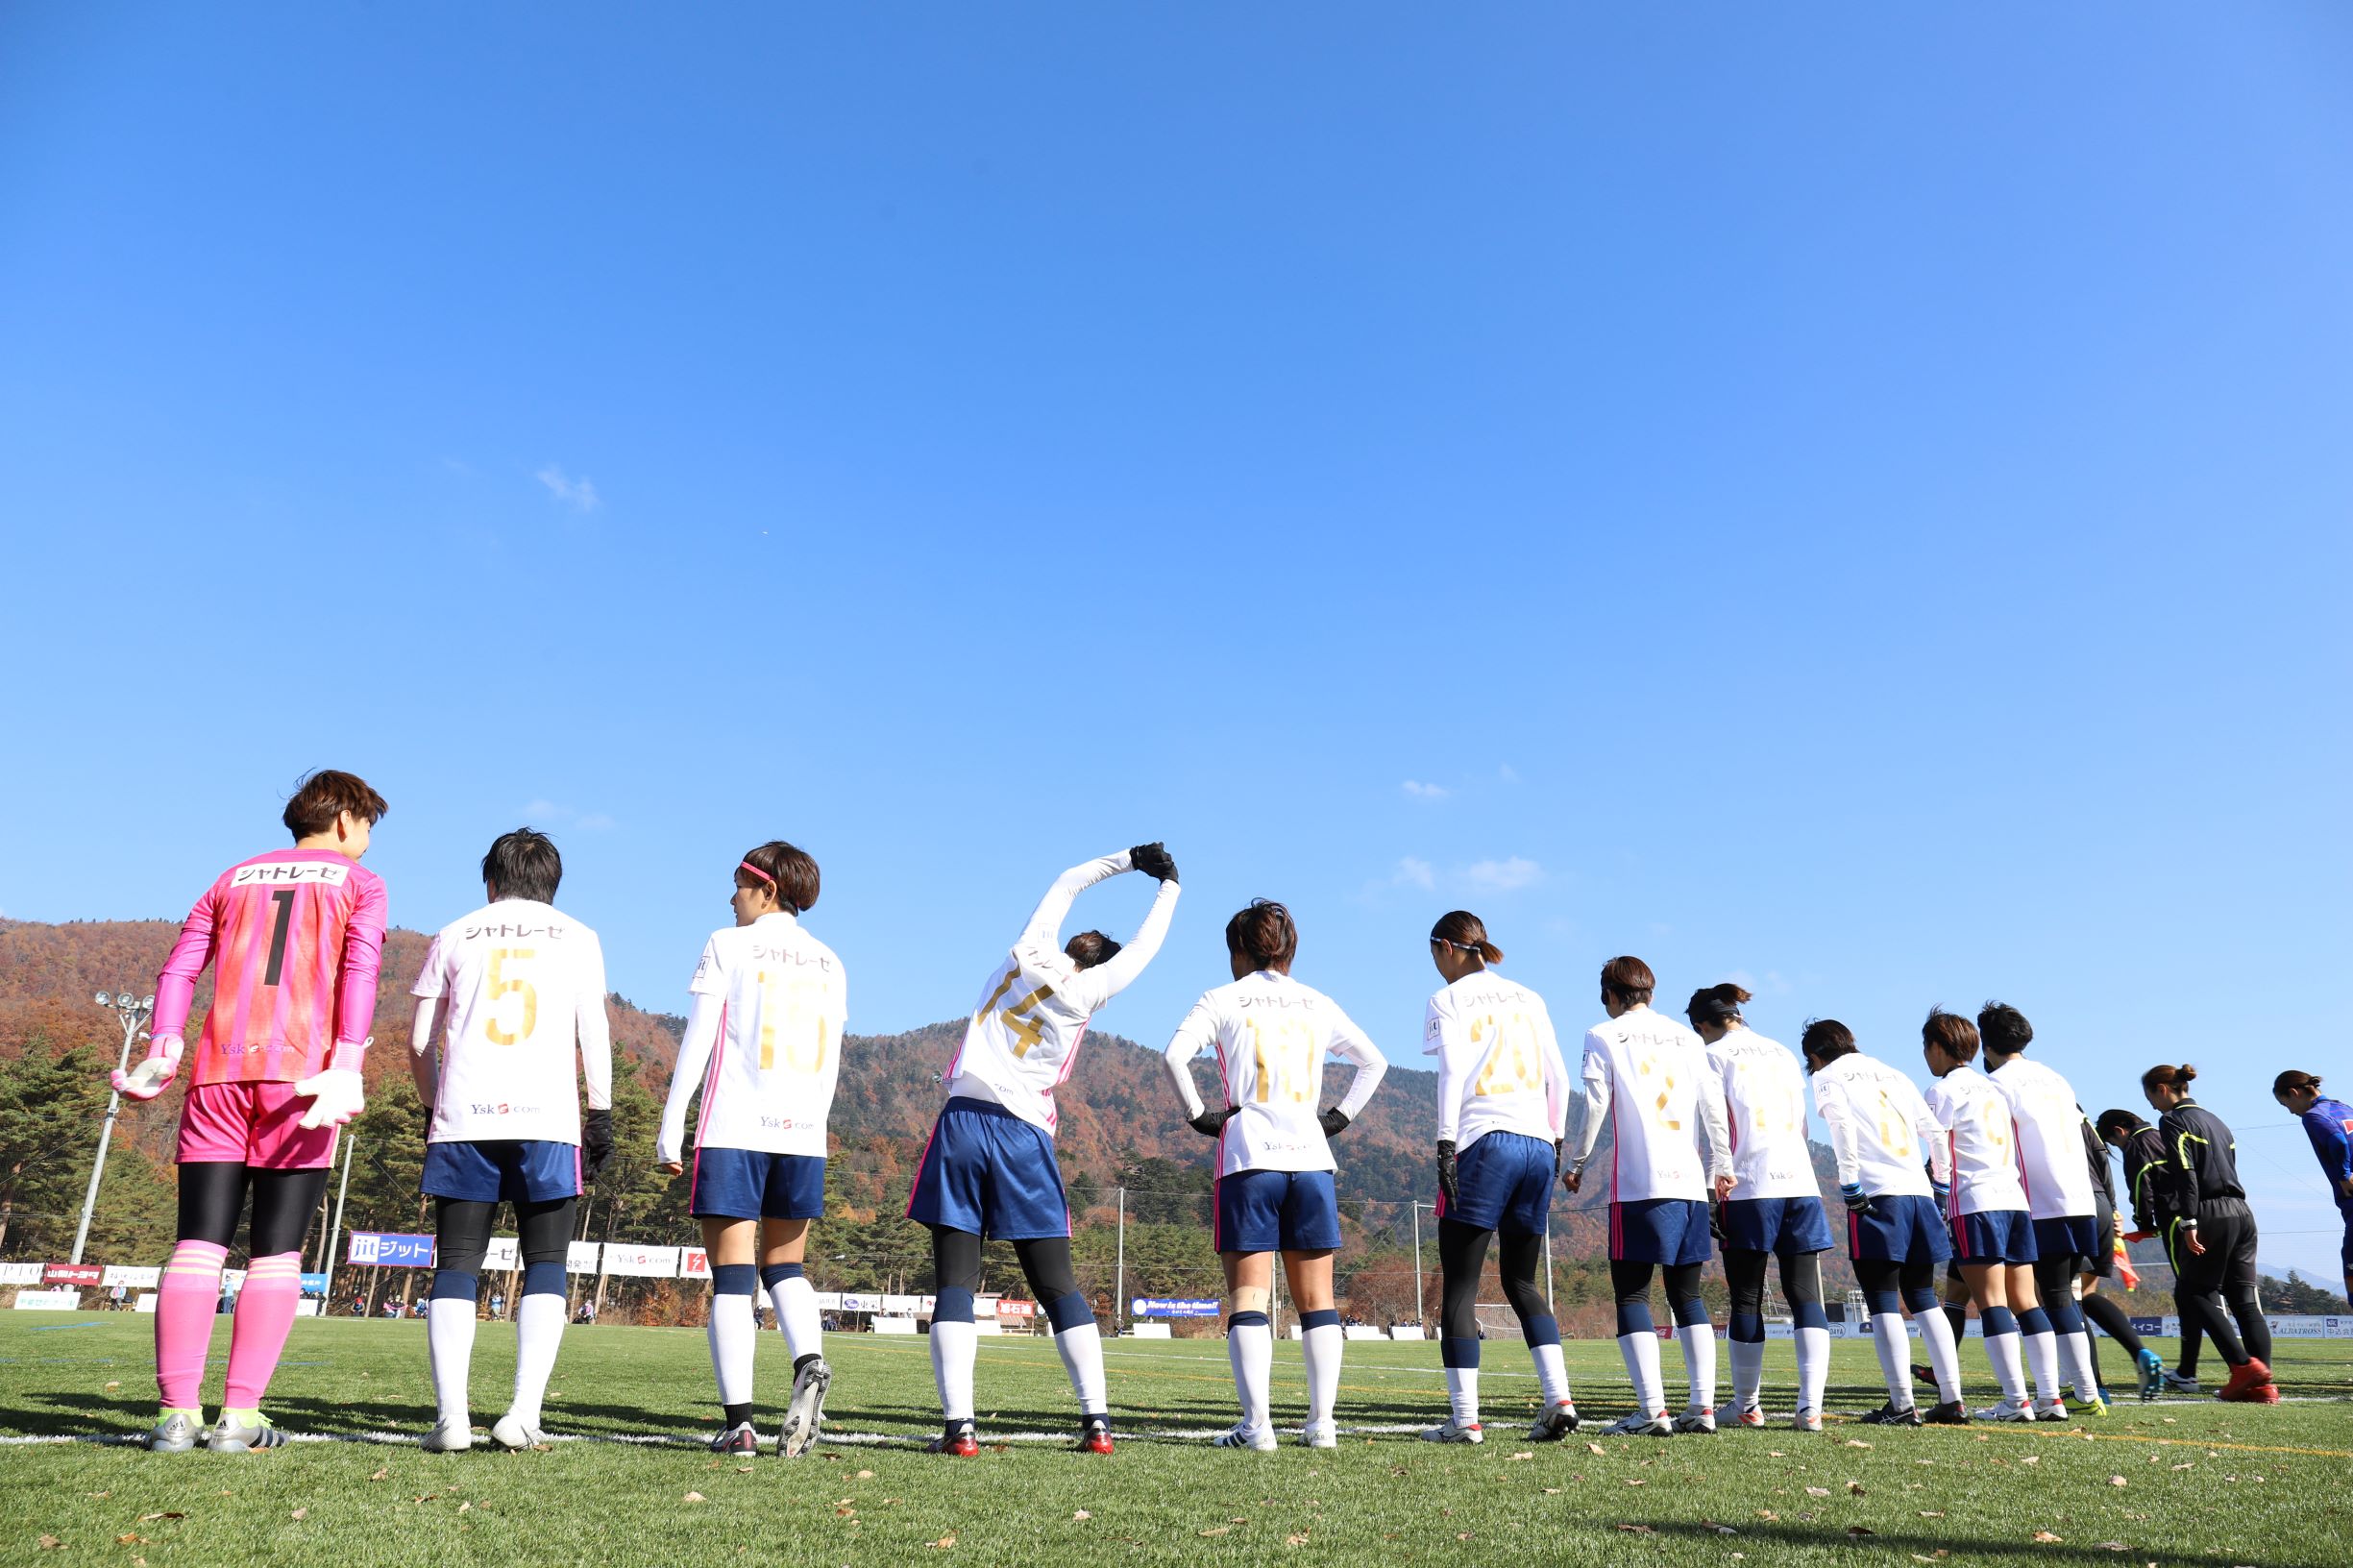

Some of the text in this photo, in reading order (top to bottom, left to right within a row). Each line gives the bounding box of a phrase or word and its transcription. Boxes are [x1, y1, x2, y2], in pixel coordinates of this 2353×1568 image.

[237, 865, 341, 882] シャトレーゼ
[264, 890, 296, 986] 1
[465, 923, 565, 941] シャトレーゼ
[752, 944, 832, 972] シャトレーゼ
[485, 948, 537, 1046] 5
[1238, 995, 1315, 1010] シャトレーゼ
[1462, 991, 1528, 1008] シャトレーゼ
[758, 970, 827, 1074] 15
[976, 967, 1055, 1060] 14
[1617, 1031, 1687, 1047] シャトレーゼ
[1469, 1014, 1543, 1096] 20
[355, 1238, 429, 1258] jit ジット
